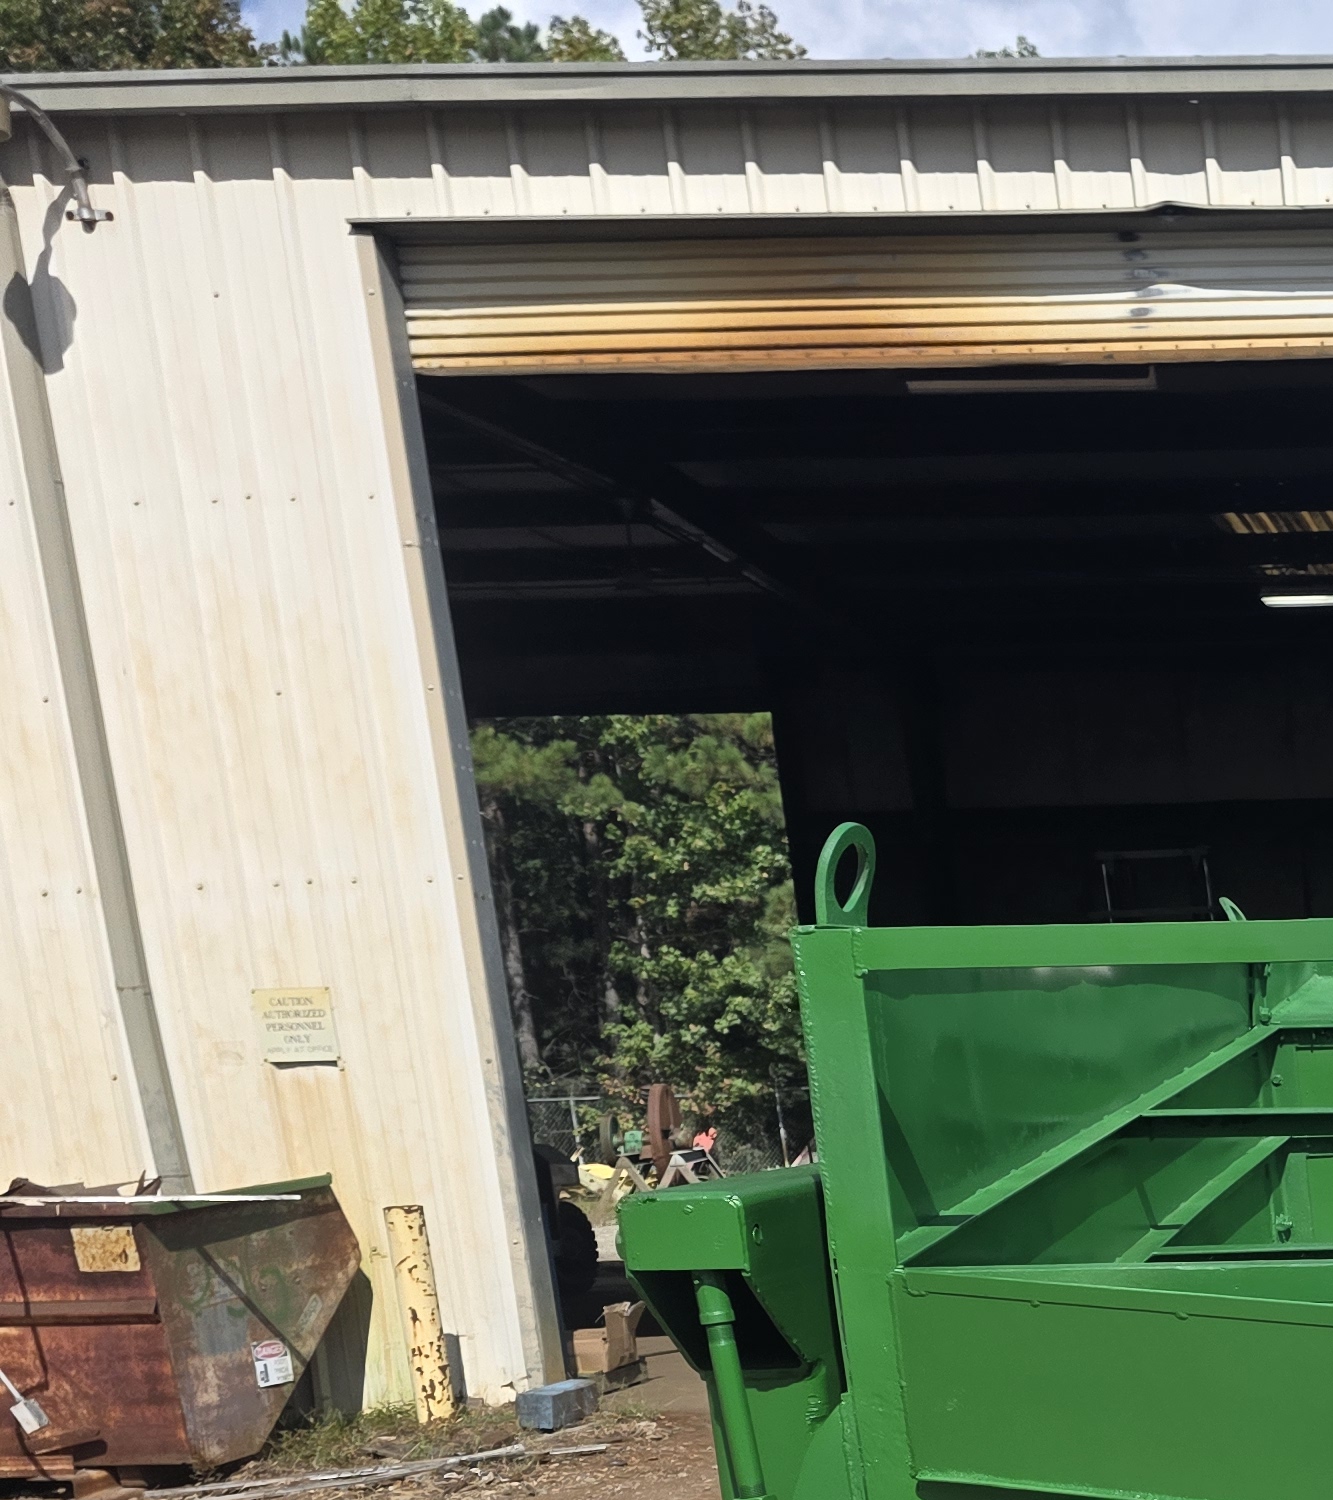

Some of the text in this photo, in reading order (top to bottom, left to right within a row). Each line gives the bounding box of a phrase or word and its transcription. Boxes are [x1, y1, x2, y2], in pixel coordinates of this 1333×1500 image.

[269, 997, 314, 1007] CAUTION
[262, 1009, 326, 1019] AUTHORIZED
[266, 1021, 325, 1032] PERSONNEL
[283, 1034, 311, 1044] ONLY
